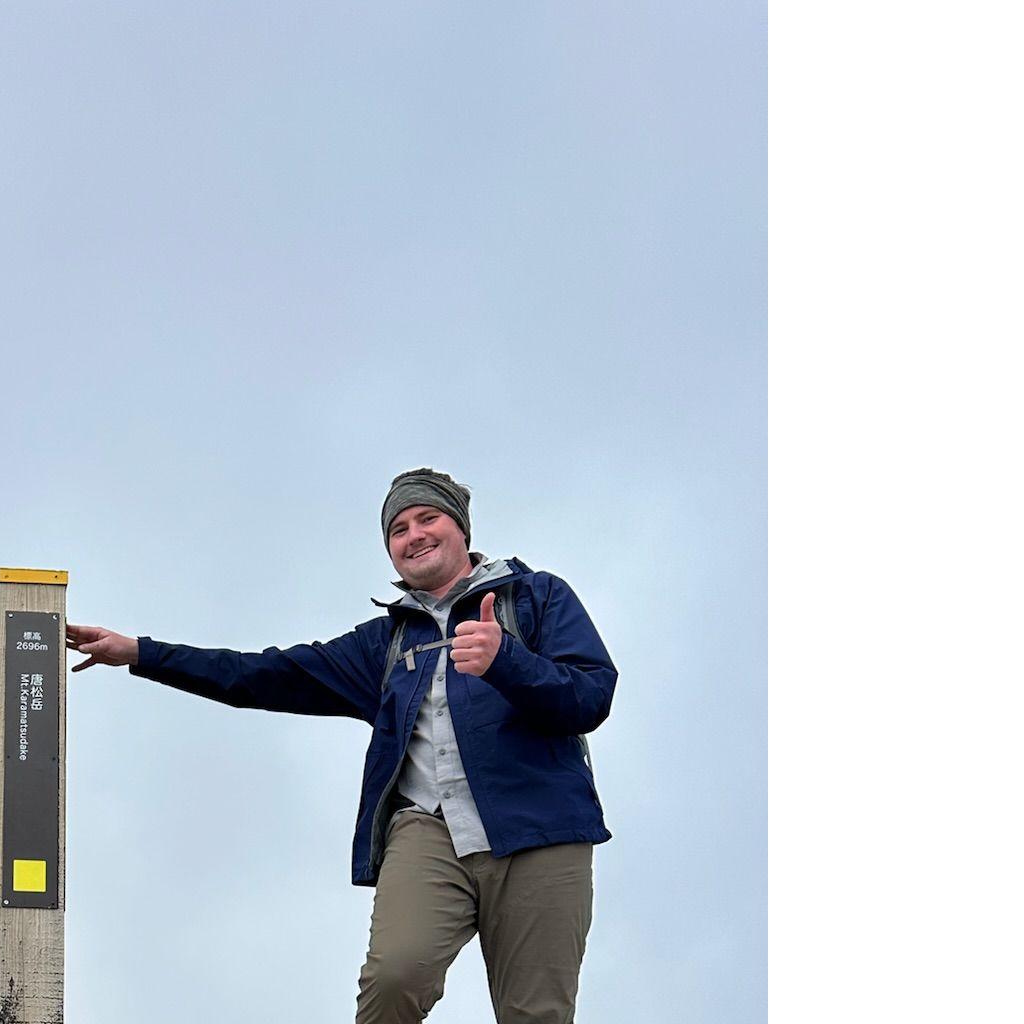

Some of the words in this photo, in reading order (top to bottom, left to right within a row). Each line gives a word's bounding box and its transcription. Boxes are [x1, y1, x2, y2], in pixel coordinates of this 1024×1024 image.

[23, 632, 42, 640] 標高
[16, 641, 48, 651] 2696m
[30, 673, 44, 711] 唐松岳
